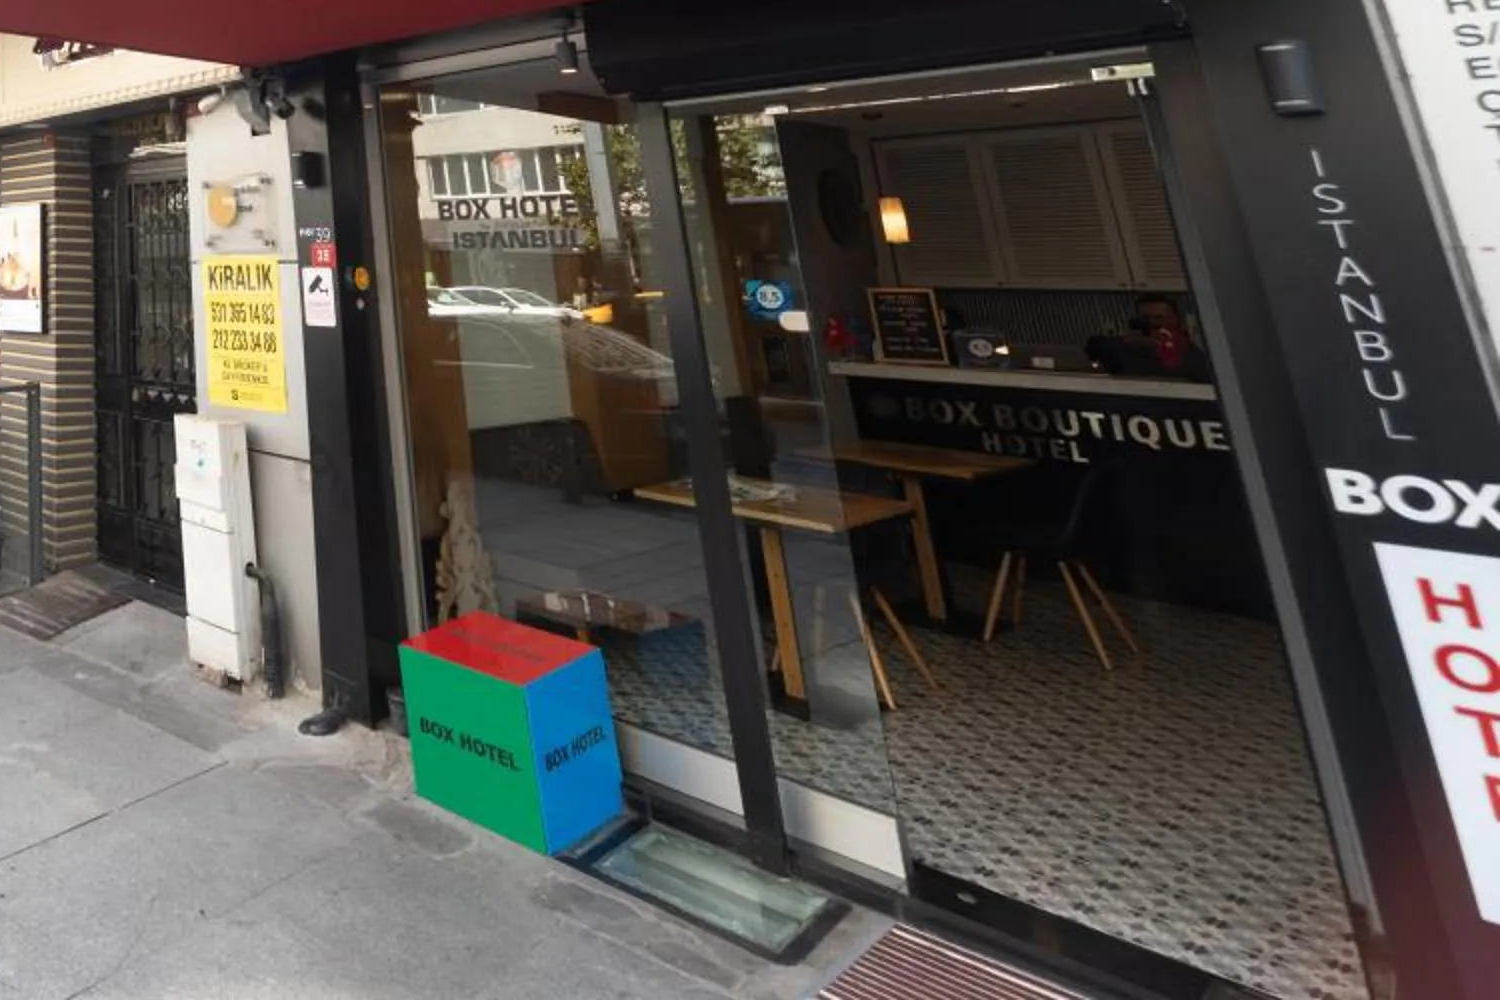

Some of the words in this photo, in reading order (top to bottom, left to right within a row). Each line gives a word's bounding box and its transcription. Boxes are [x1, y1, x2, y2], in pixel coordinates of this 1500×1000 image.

[438, 198, 490, 221] BOX
[500, 194, 594, 222] HOTE
[452, 230, 585, 250] ISTANBUL
[1310, 148, 1417, 441] ISTANBUL
[212, 328, 228, 351] 212
[904, 396, 983, 427] BOX
[992, 404, 1232, 452] BOUTIQUE
[981, 430, 1090, 464] HOTEL
[1324, 467, 1500, 531] BOX
[419, 716, 455, 745] BOX
[459, 731, 523, 773] HOTEL
[544, 743, 571, 773] BOX
[571, 725, 607, 759] HOTEL
